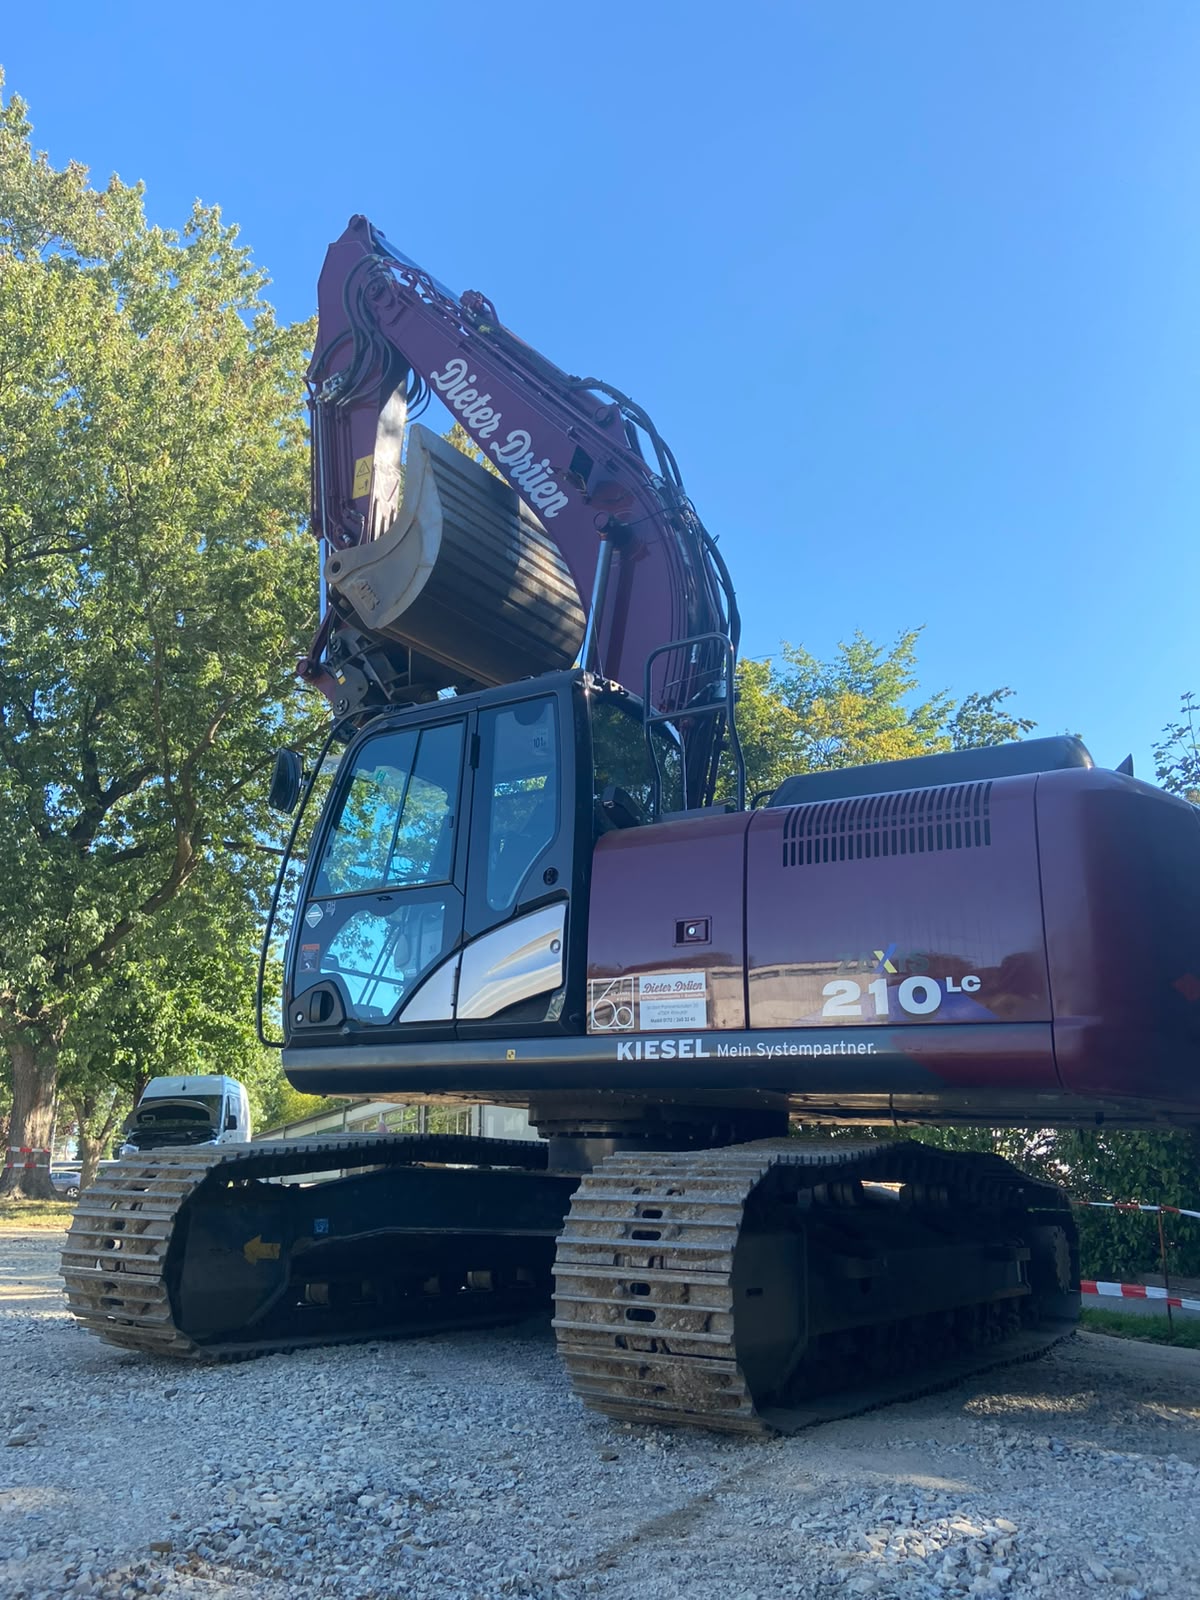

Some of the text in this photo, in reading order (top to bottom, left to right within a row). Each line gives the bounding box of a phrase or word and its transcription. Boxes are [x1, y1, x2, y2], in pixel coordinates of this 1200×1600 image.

[430, 358, 569, 518] Dieter Drüen
[836, 943, 930, 976] ZAXIS
[642, 982, 672, 994] Dieter
[672, 980, 703, 992] Drüen
[822, 975, 982, 1017] 210 LC
[616, 1038, 877, 1061] KIESEL Mein Systempartner.
